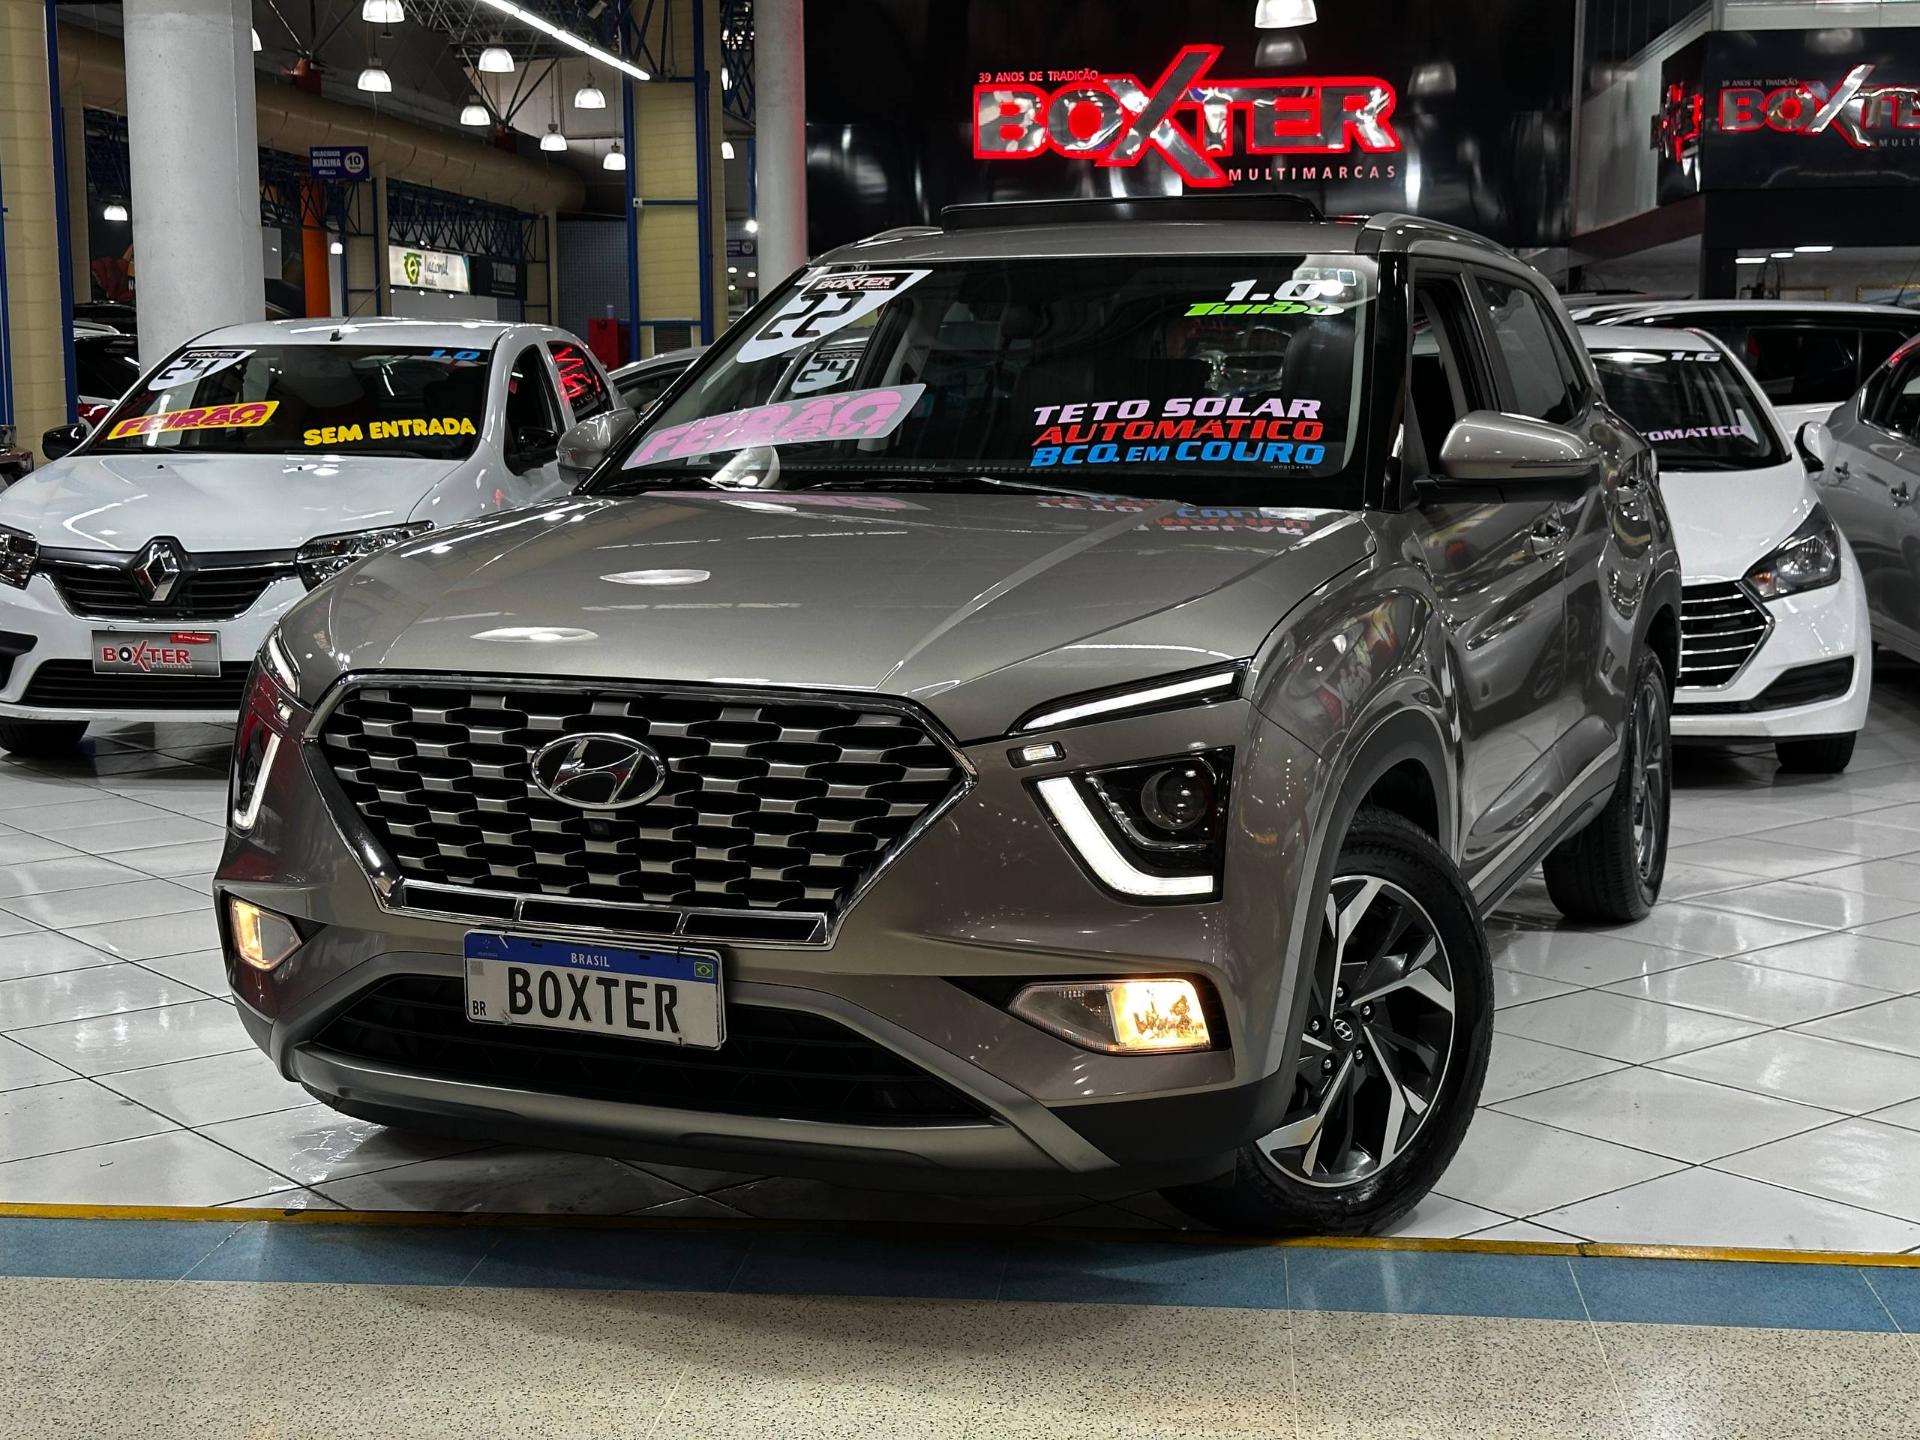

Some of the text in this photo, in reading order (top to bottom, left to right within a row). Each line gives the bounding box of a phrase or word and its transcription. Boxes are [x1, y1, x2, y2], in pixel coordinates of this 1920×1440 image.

[979, 72, 992, 83] 39
[995, 71, 1025, 83] ANOS
[1029, 71, 1043, 82] DE
[973, 44, 1404, 187] BOXTER
[347, 155, 361, 166] 10
[1229, 165, 1397, 182] MULTIMARCAS
[815, 274, 896, 291] BOXTER
[754, 291, 866, 341] 22
[429, 349, 481, 361] 1.0
[157, 357, 220, 380] 24
[797, 359, 856, 382] 24
[1033, 397, 1321, 426] TETO SOLAR
[303, 417, 477, 446] SEM ENTRADA
[1029, 441, 1325, 467] BCO. EM COURO
[102, 640, 192, 672] BOXTER
[570, 952, 611, 968] BRASIL
[472, 1000, 487, 1017] BR
[507, 966, 681, 1034] BOXTER
